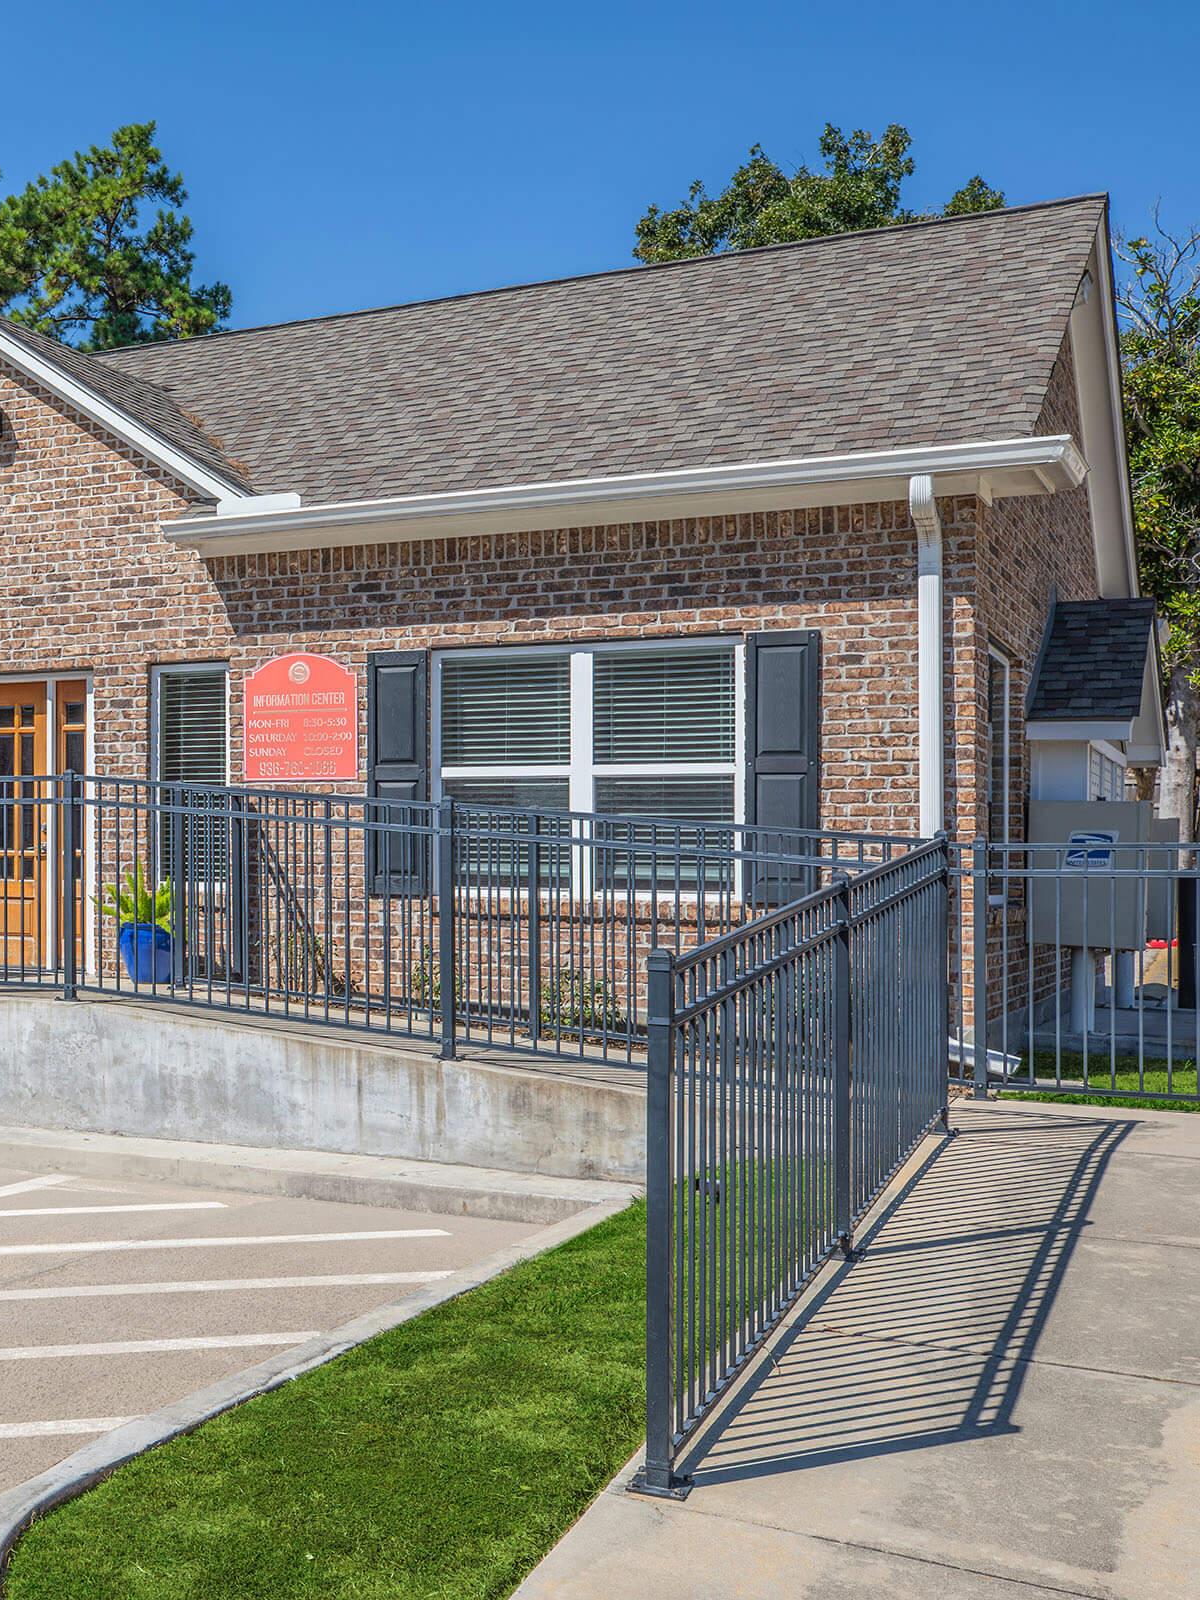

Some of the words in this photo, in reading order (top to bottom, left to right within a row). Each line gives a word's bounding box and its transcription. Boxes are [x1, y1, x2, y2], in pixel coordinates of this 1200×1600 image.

[253, 693, 310, 707] INFORMATION
[312, 692, 345, 705] CENTER
[248, 719, 290, 729] MON-FRI
[303, 717, 347, 728] 8:30-5:30
[248, 732, 297, 743] SATURDAY
[303, 731, 353, 742] 10:00-2:00
[248, 747, 288, 758] SUNDAY
[303, 746, 343, 757] CLOSED
